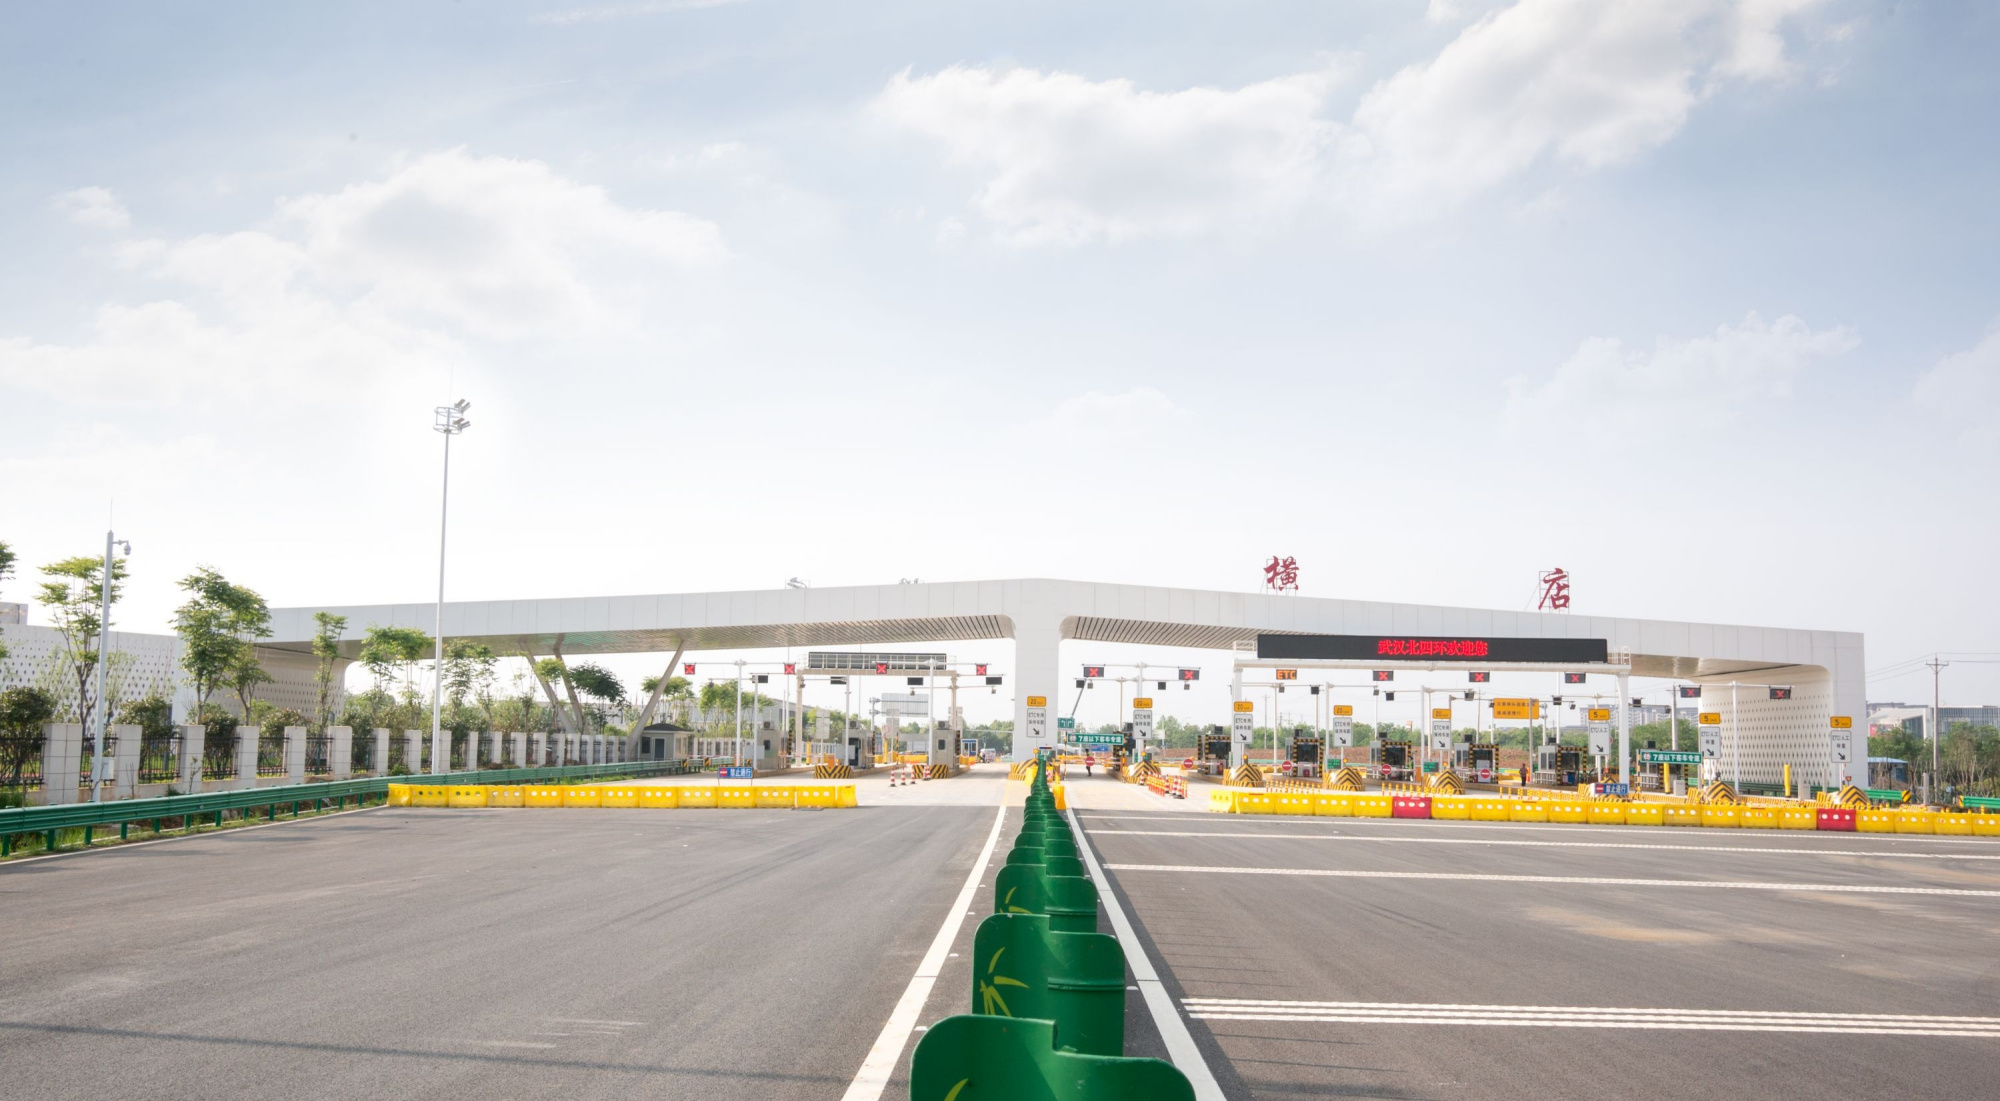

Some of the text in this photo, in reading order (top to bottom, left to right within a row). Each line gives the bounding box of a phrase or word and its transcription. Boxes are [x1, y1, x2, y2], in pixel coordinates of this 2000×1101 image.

[1538, 567, 1570, 610] 店
[1377, 639, 1488, 657] 武汉北四环欢迎您
[1277, 670, 1296, 680] ETC
[730, 768, 751, 777] 禁止通行
[1605, 783, 1627, 795] 禁止通行
